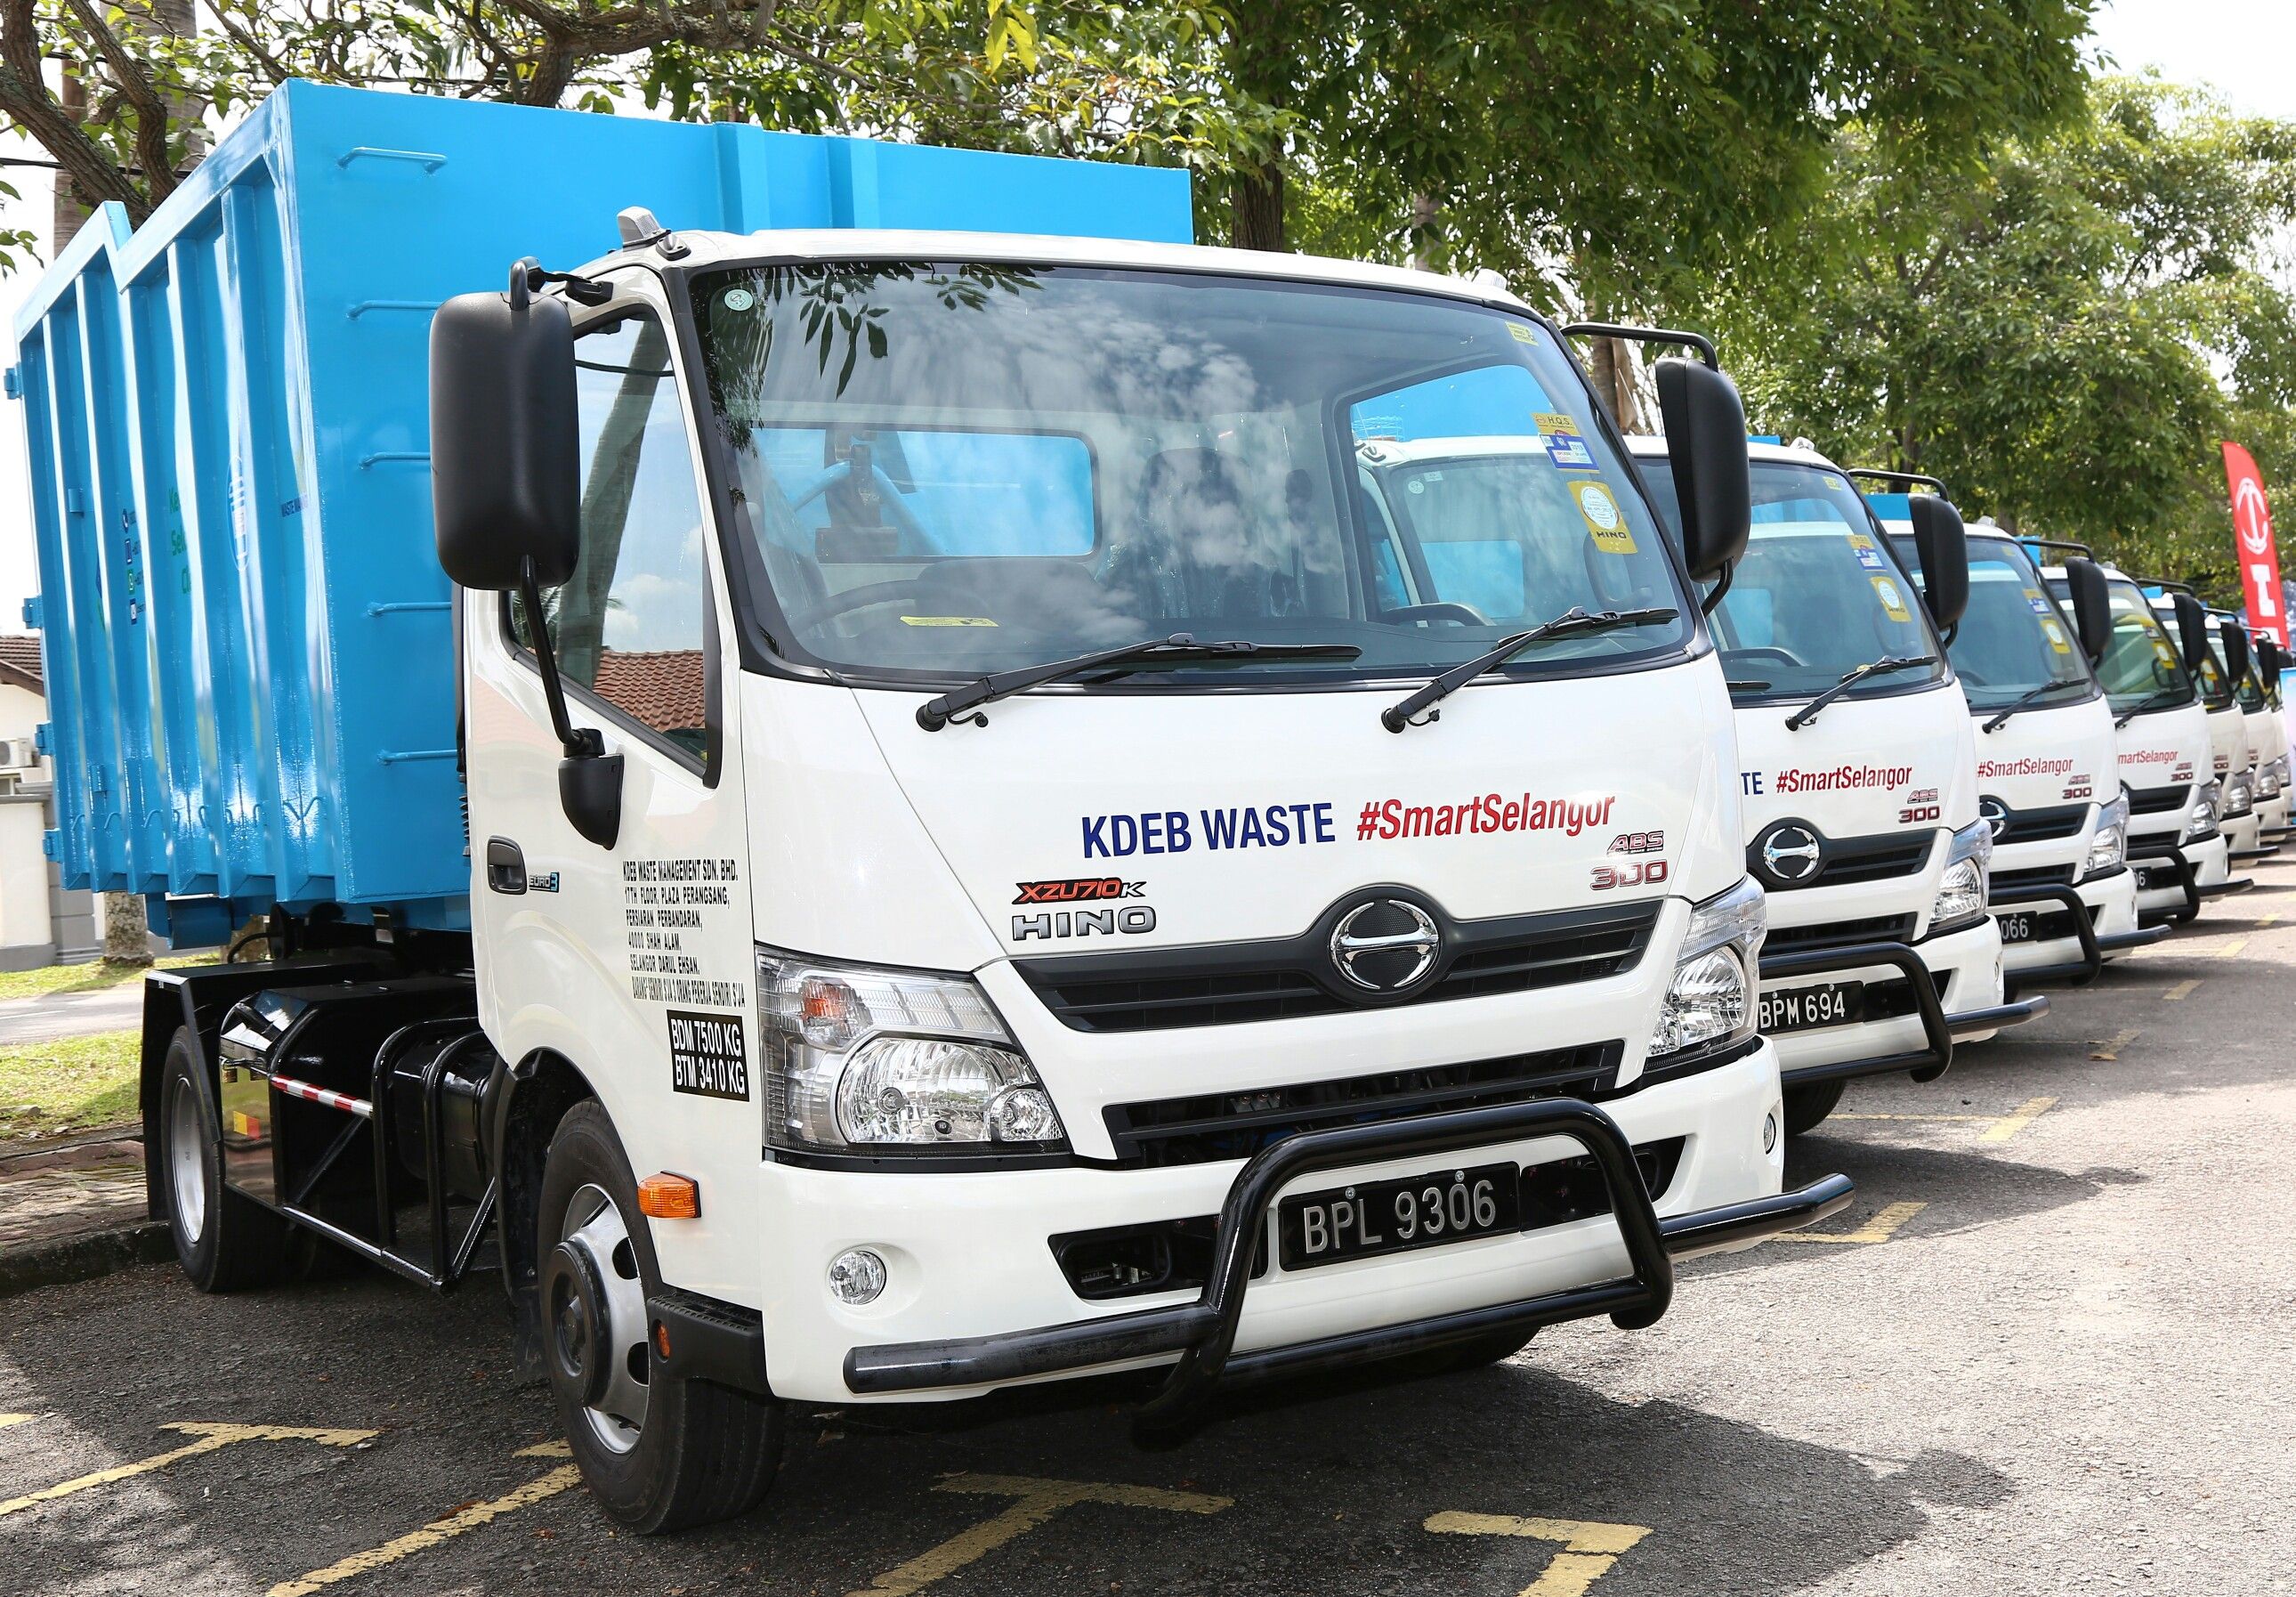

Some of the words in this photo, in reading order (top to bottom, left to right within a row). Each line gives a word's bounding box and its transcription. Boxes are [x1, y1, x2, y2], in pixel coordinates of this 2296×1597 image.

[1977, 758, 2074, 777] #SmartSelangor
[1741, 772, 1764, 795] TE
[1776, 766, 1912, 790] #SmartSelangor
[2062, 787, 2092, 799] 300
[1082, 811, 1192, 858] KDEB
[1201, 802, 1335, 850] WASTE
[1357, 793, 1615, 841] #SmartSelangor
[1898, 806, 1940, 823] 300
[1606, 831, 1663, 852] ABS
[623, 861, 636, 881] KDEB
[638, 861, 657, 881] WASTE
[659, 859, 700, 881] MANAGEMENT
[702, 859, 718, 880] SDN.
[721, 859, 738, 880] BHD.
[625, 887, 637, 904] 17TH
[641, 887, 659, 908] FLOOR,
[661, 887, 680, 904] PLAZA
[683, 887, 730, 909] PERANGSANG,
[1012, 876, 1147, 904] XZU710K
[626, 909, 654, 927] PERSIARAN
[658, 910, 702, 931] PERBANDARAN,
[1012, 905, 1156, 941] HINO
[2001, 918, 2028, 940] 066
[646, 932, 661, 950] SHAH
[664, 933, 682, 954] ALAM,
[629, 953, 656, 972] SELANGOR
[659, 955, 676, 973] DARUL
[678, 956, 699, 975] EHSAN.
[1758, 997, 1799, 1028] BPM
[1805, 992, 1845, 1023] 694
[671, 1018, 694, 1051] BDM
[694, 1020, 722, 1055] 7500
[724, 1023, 741, 1057] KG
[675, 1054, 697, 1087] BTM
[699, 1057, 725, 1091] 3410
[727, 1060, 745, 1094] KG
[1304, 1199, 1382, 1254] BPL
[1395, 1180, 1496, 1239] 9306
